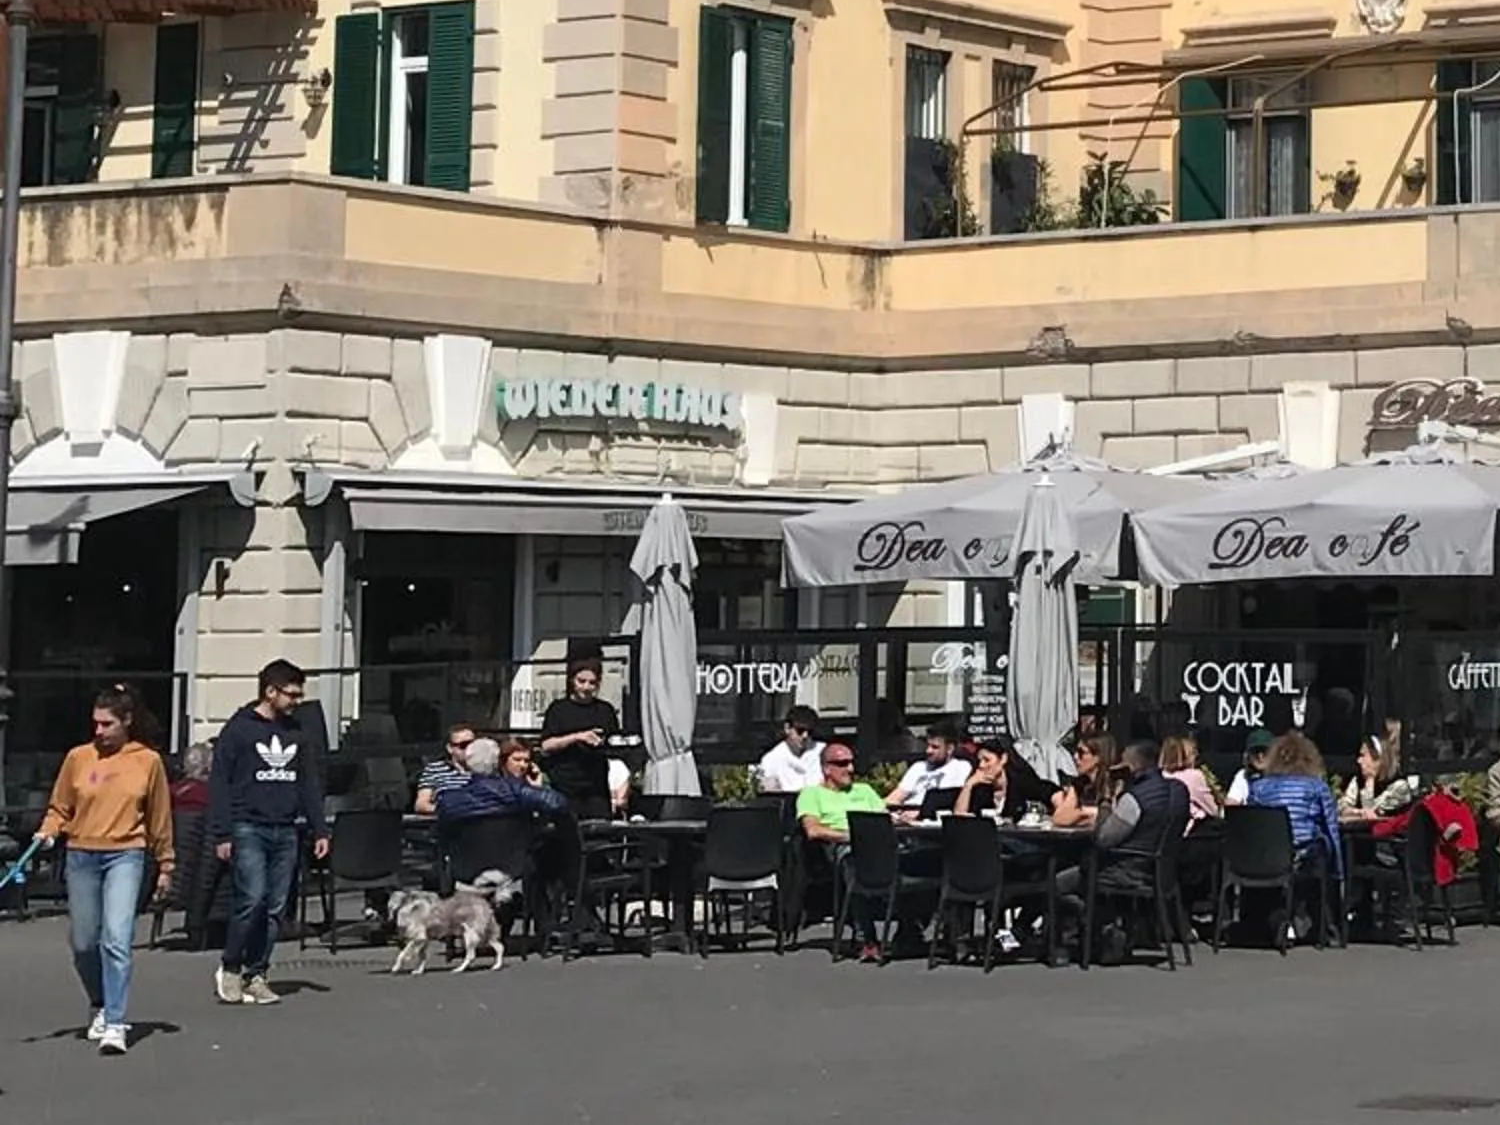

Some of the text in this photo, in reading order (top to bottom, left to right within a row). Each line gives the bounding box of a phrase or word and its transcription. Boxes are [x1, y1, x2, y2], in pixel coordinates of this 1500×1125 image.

[496, 378, 742, 428] WIENER HAUS
[853, 521, 948, 572] Dea
[1207, 516, 1310, 570] Dea
[695, 661, 802, 695] HOTTERIA
[1183, 661, 1301, 694] COCKTAIL
[1218, 694, 1265, 726] BAR
[255, 768, 297, 781] adidas
